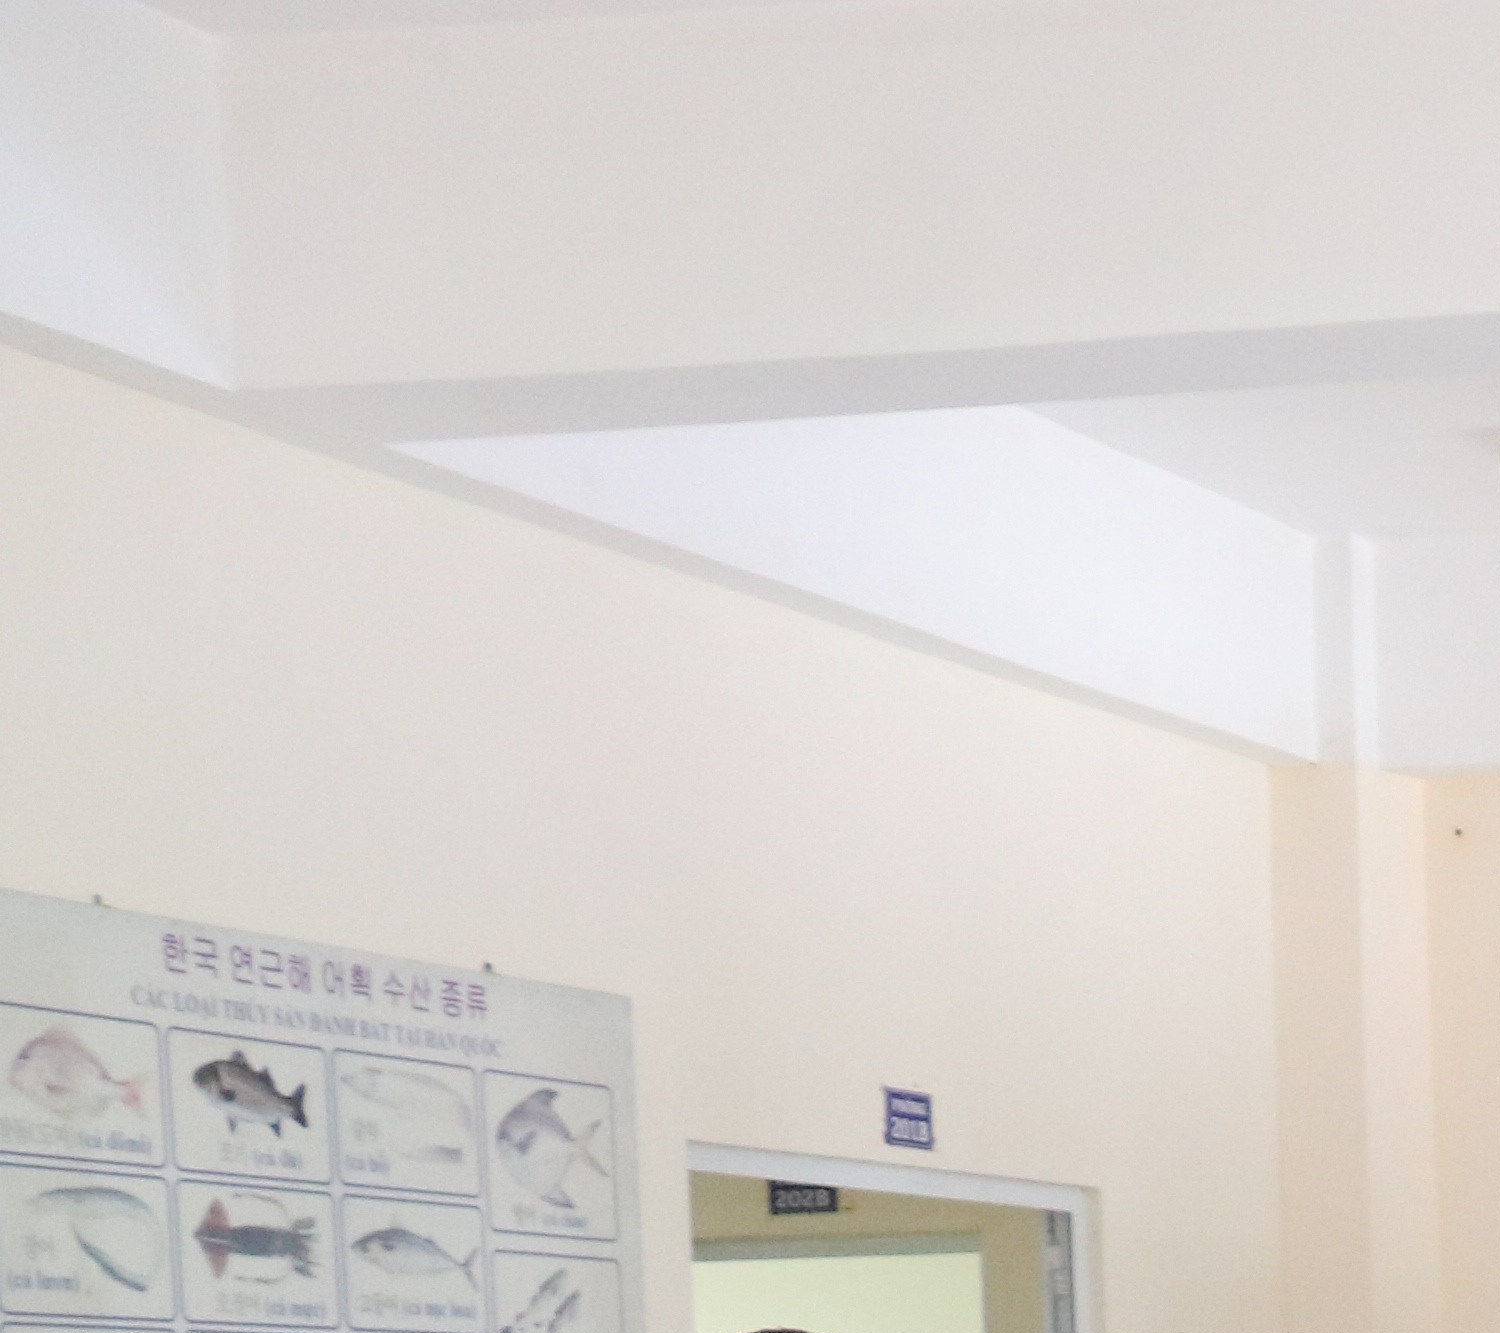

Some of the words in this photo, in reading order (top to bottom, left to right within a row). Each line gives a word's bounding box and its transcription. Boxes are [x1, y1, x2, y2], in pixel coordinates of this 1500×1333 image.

[162, 933, 219, 979] 한국
[229, 944, 311, 995] 연근해
[322, 960, 373, 1001] 어획
[383, 970, 431, 1012] 수산
[441, 979, 488, 1019] 종류
